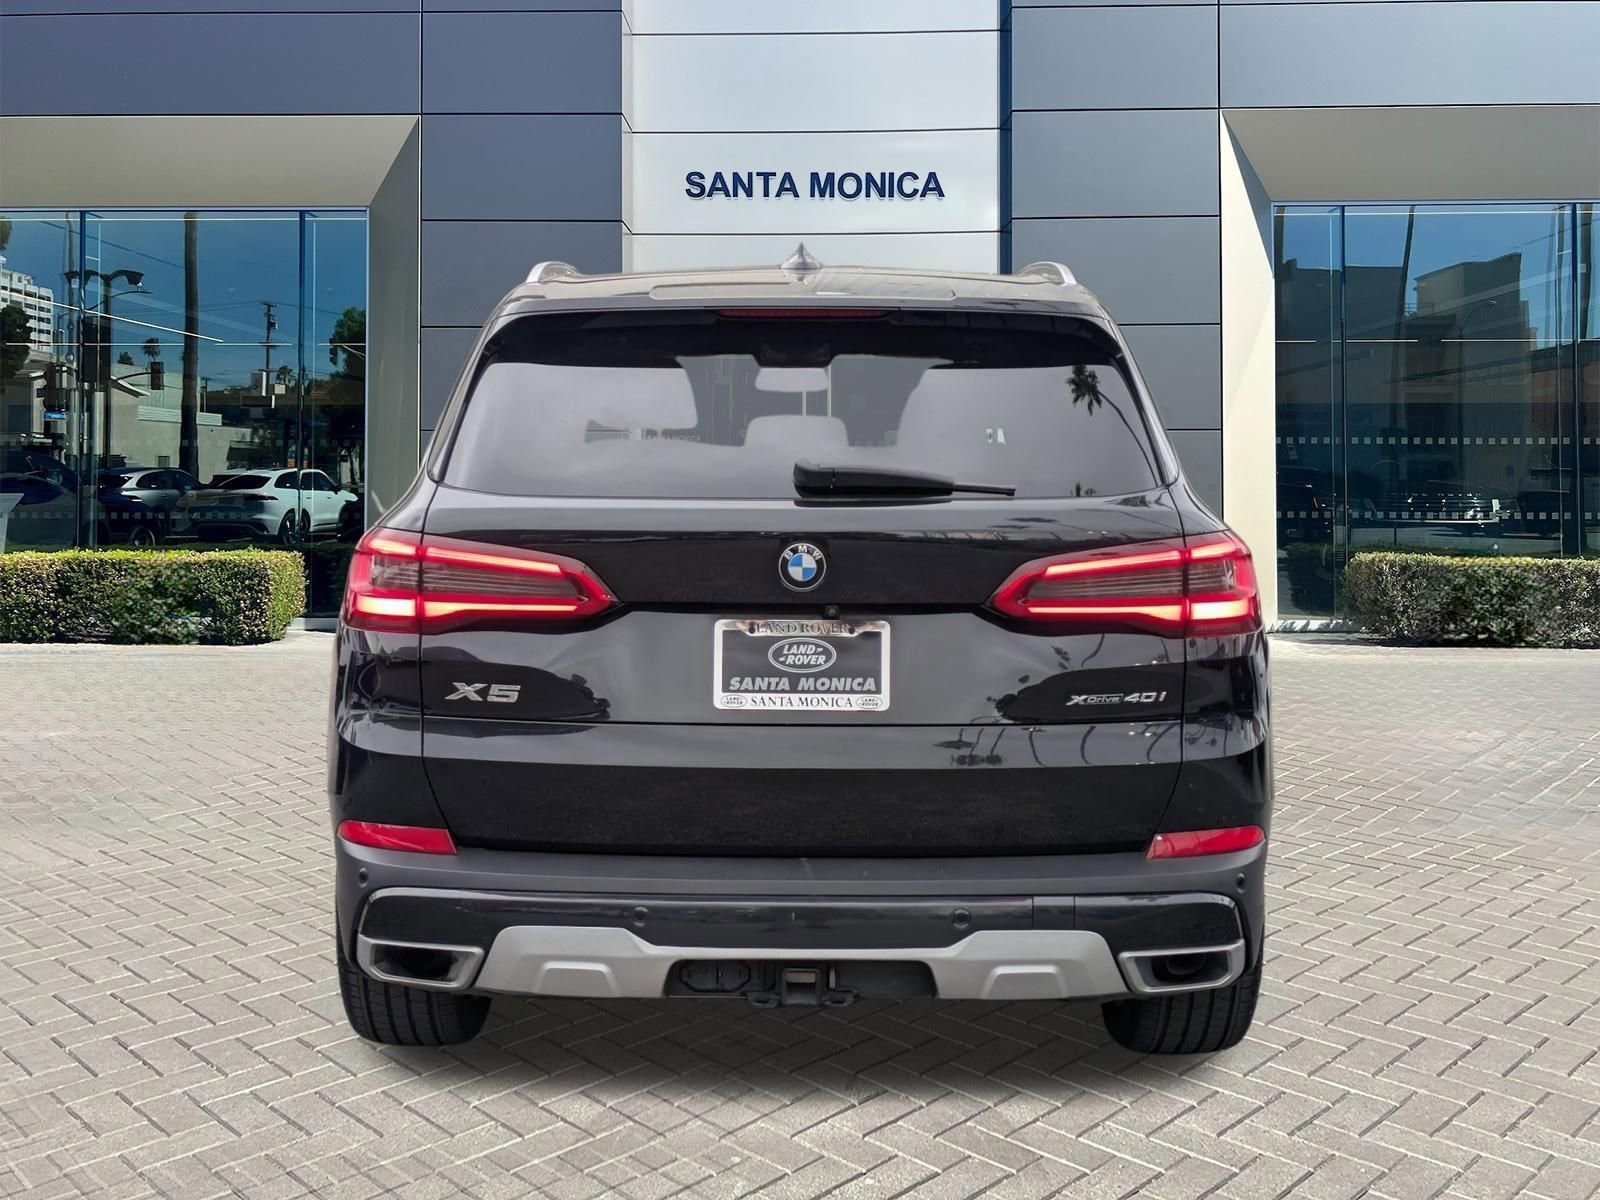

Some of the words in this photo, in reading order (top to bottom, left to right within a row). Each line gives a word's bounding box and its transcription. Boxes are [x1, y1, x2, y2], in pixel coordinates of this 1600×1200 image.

[685, 171, 800, 200] SANTA
[808, 171, 946, 200] MONICA
[784, 545, 823, 560] BMW
[756, 621, 798, 634] LAND
[799, 622, 850, 634] ROVER
[783, 644, 815, 654] LAND
[785, 654, 826, 665] ROVER
[729, 677, 791, 691] SANTA
[797, 678, 876, 692] MONICA
[444, 682, 521, 703] X5
[751, 696, 794, 708] SANTA
[796, 696, 853, 708] MONICA
